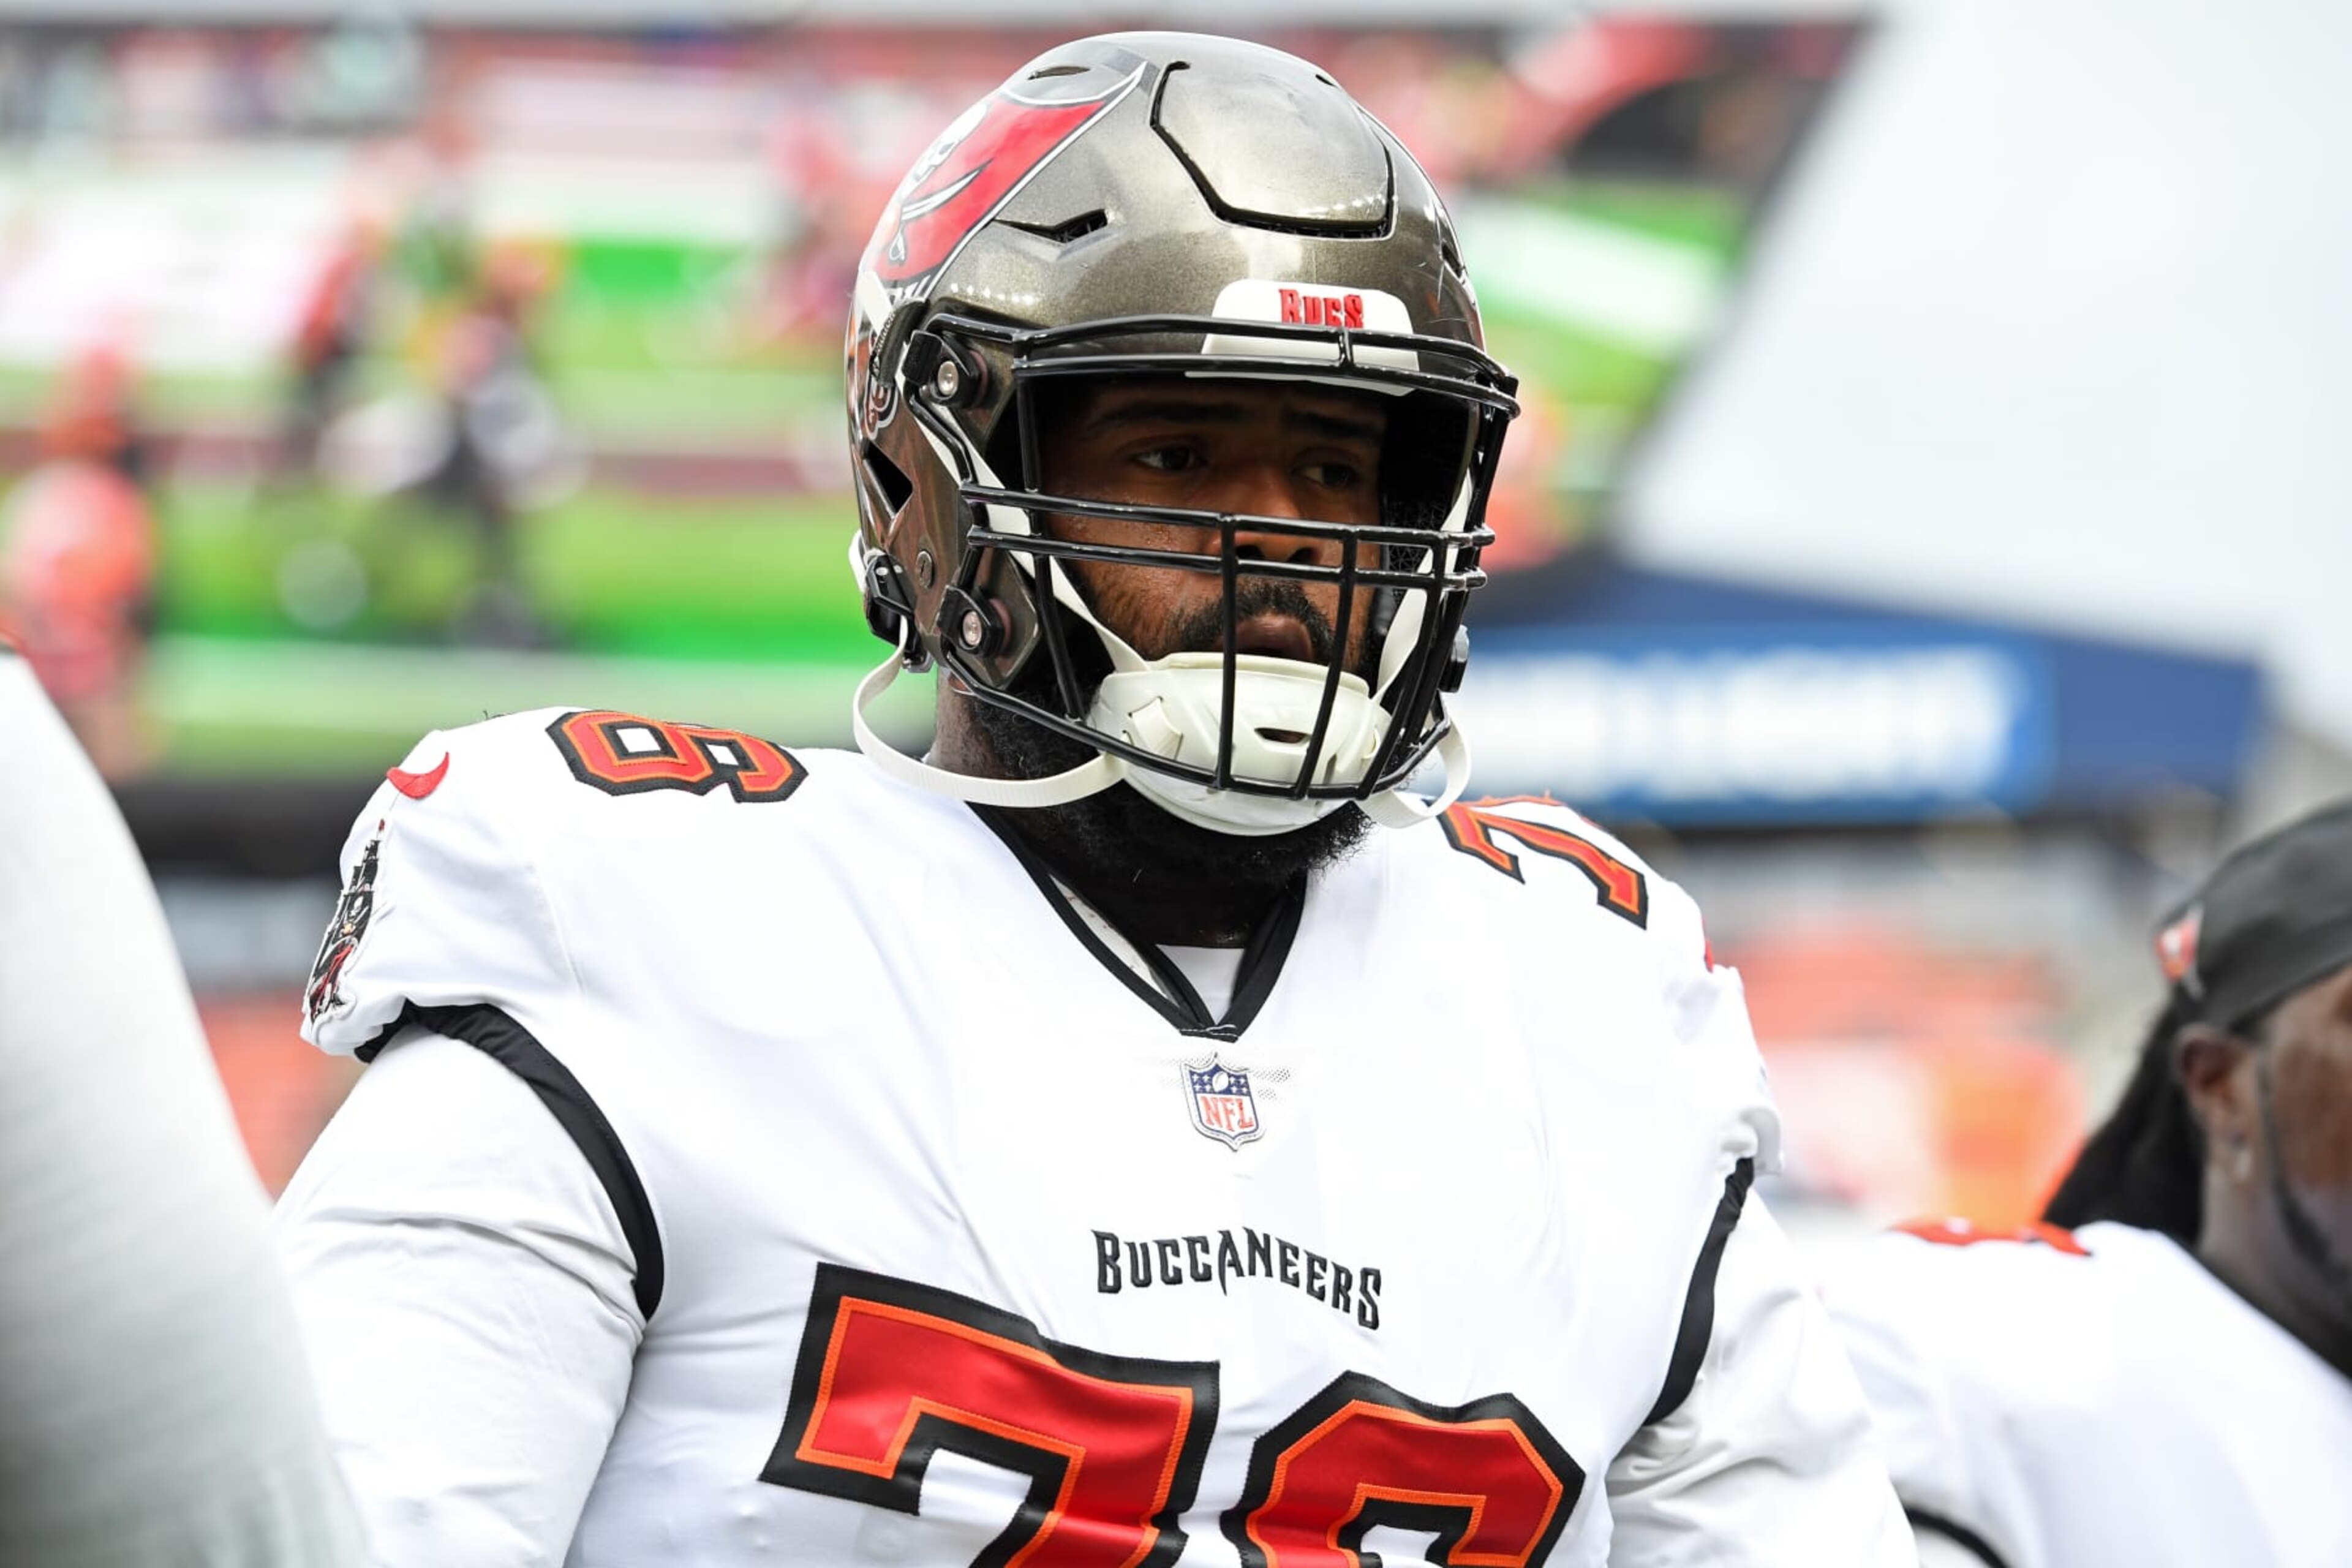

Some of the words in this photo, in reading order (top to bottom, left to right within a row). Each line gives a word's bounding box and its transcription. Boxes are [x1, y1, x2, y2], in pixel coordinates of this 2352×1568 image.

[1435, 794, 1649, 931] 7
[1199, 1095, 1254, 1133] NFL
[1090, 1226, 1382, 1331] BUCCANEERS
